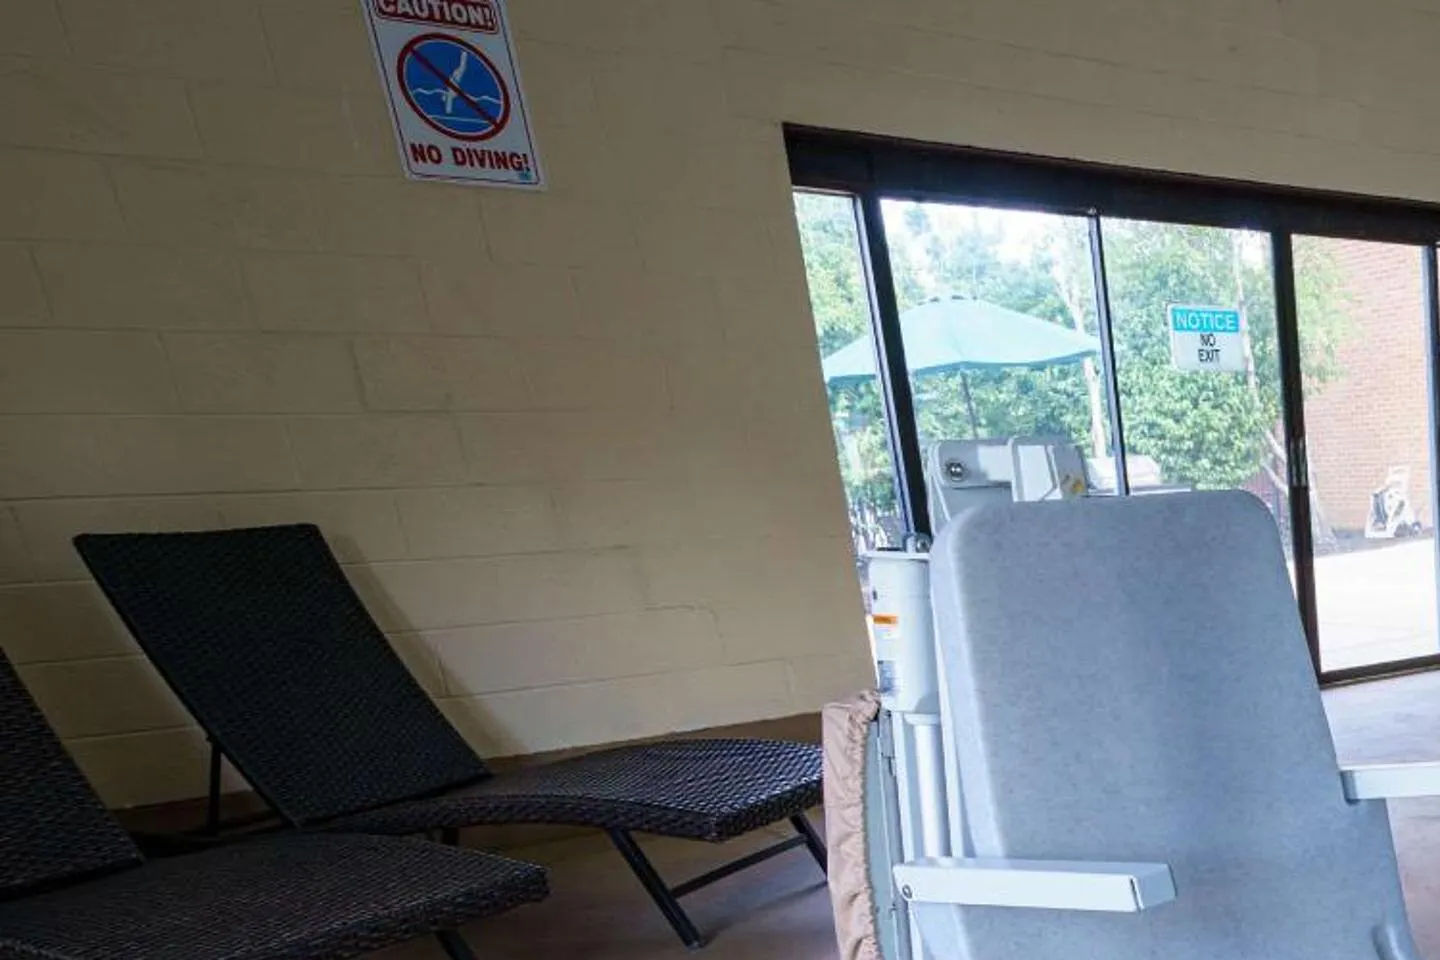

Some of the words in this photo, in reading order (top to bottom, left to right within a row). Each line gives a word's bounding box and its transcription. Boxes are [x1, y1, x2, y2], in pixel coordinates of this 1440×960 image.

[377, 0, 498, 26] CAUTION!
[410, 143, 442, 165] NO
[451, 146, 530, 172] DIVING!
[1174, 311, 1237, 330] NOTICE
[1200, 333, 1216, 347] NO
[1198, 348, 1220, 363] EXIT
